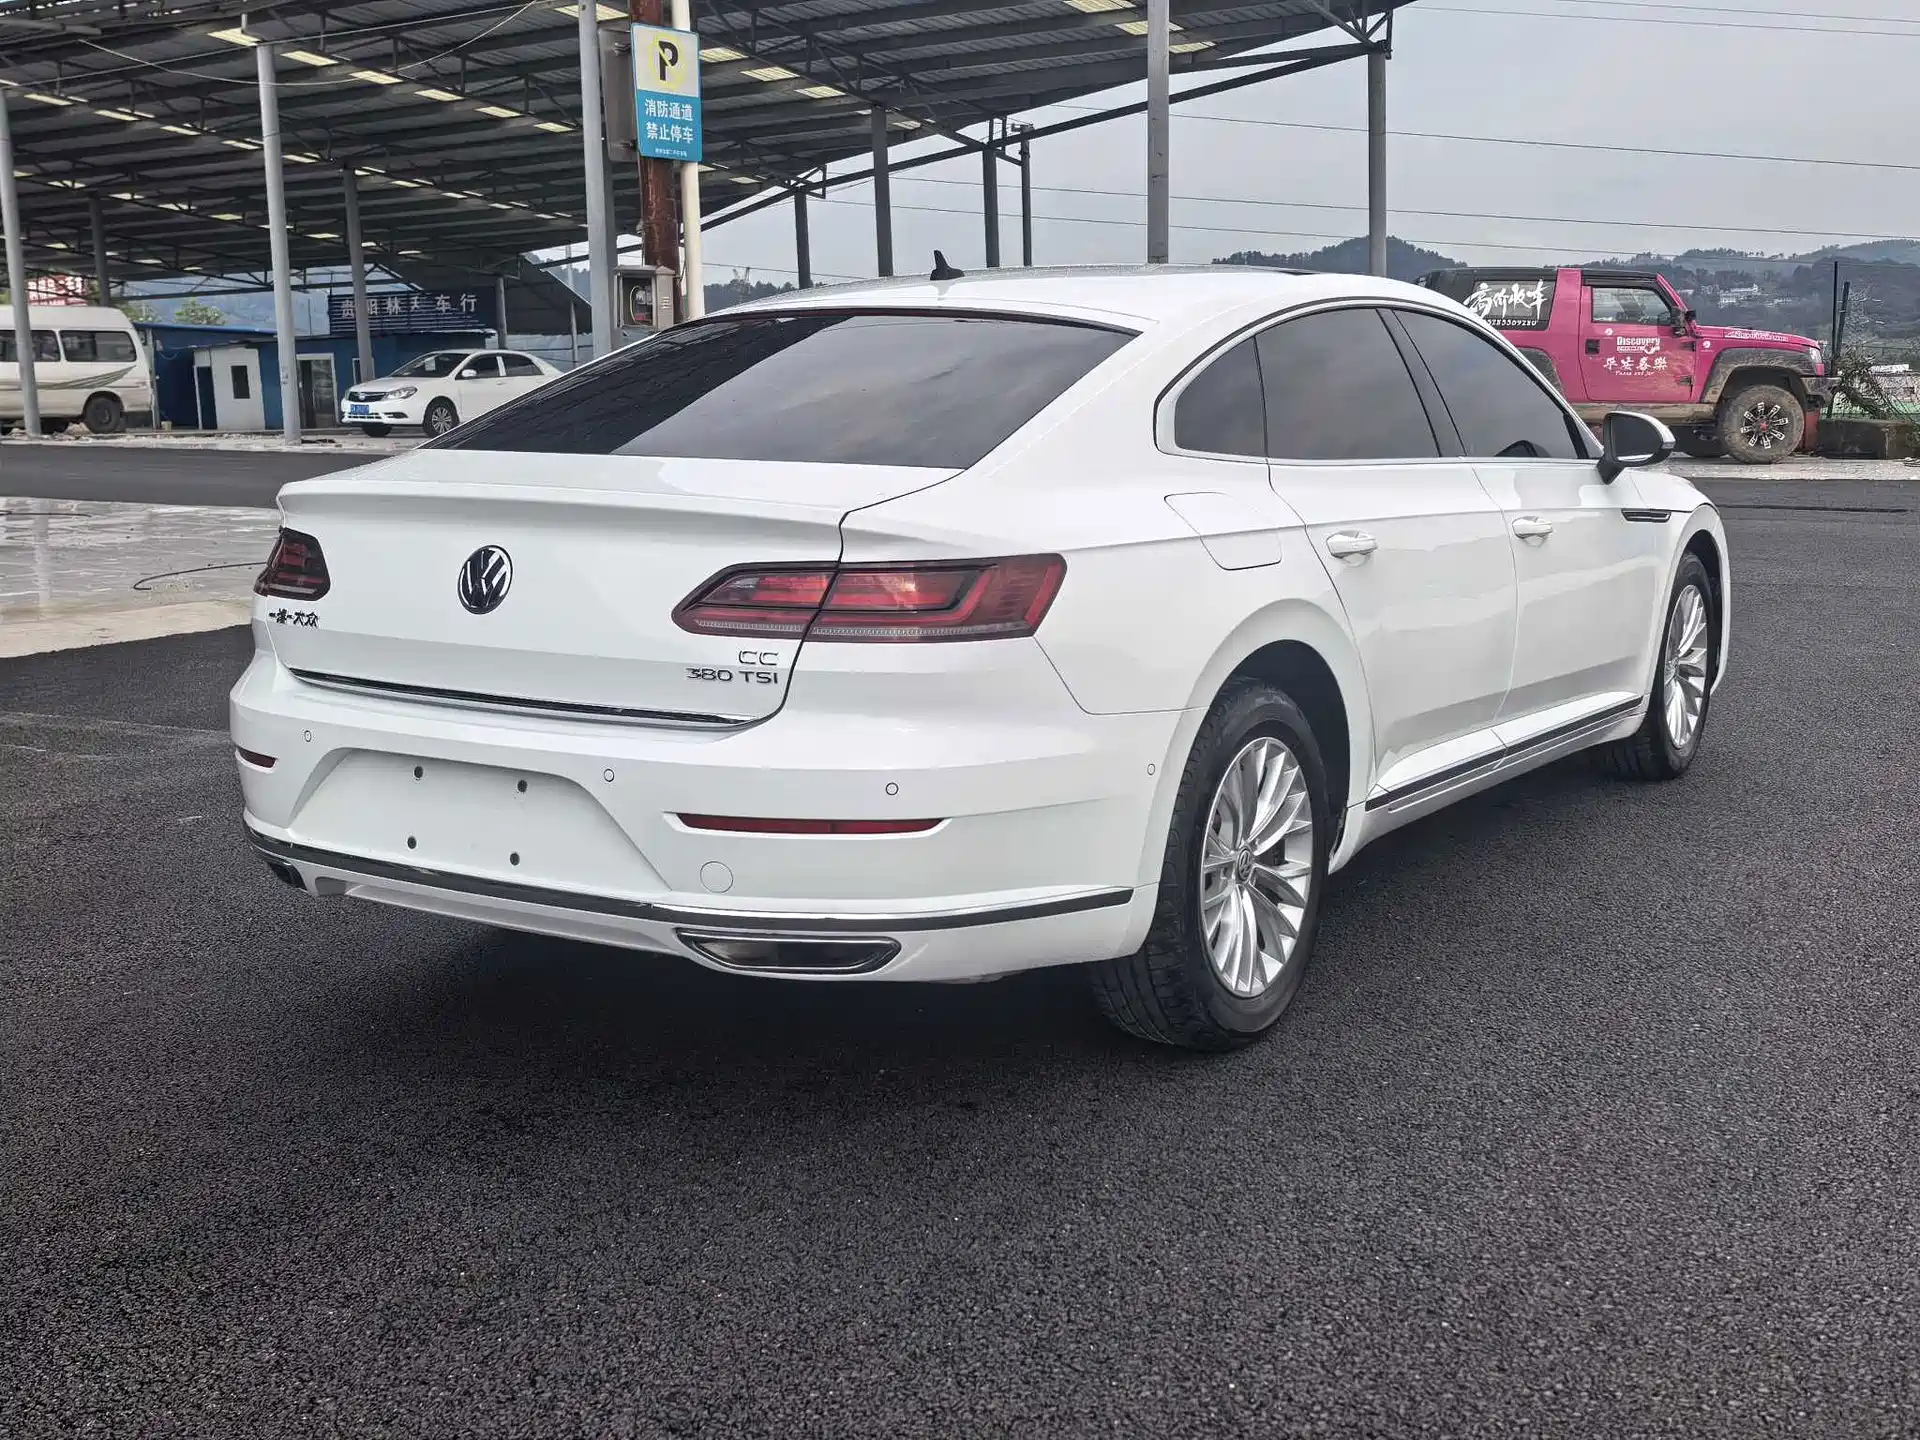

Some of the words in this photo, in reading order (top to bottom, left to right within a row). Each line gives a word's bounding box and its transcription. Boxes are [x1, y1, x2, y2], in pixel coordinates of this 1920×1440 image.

[658, 40, 678, 81] P
[644, 98, 693, 121] 消防通道
[645, 121, 694, 144] 禁止停车
[1616, 336, 1660, 346] Discovery
[738, 650, 779, 666] CC
[685, 667, 733, 682] 380
[739, 670, 778, 684] TSI
